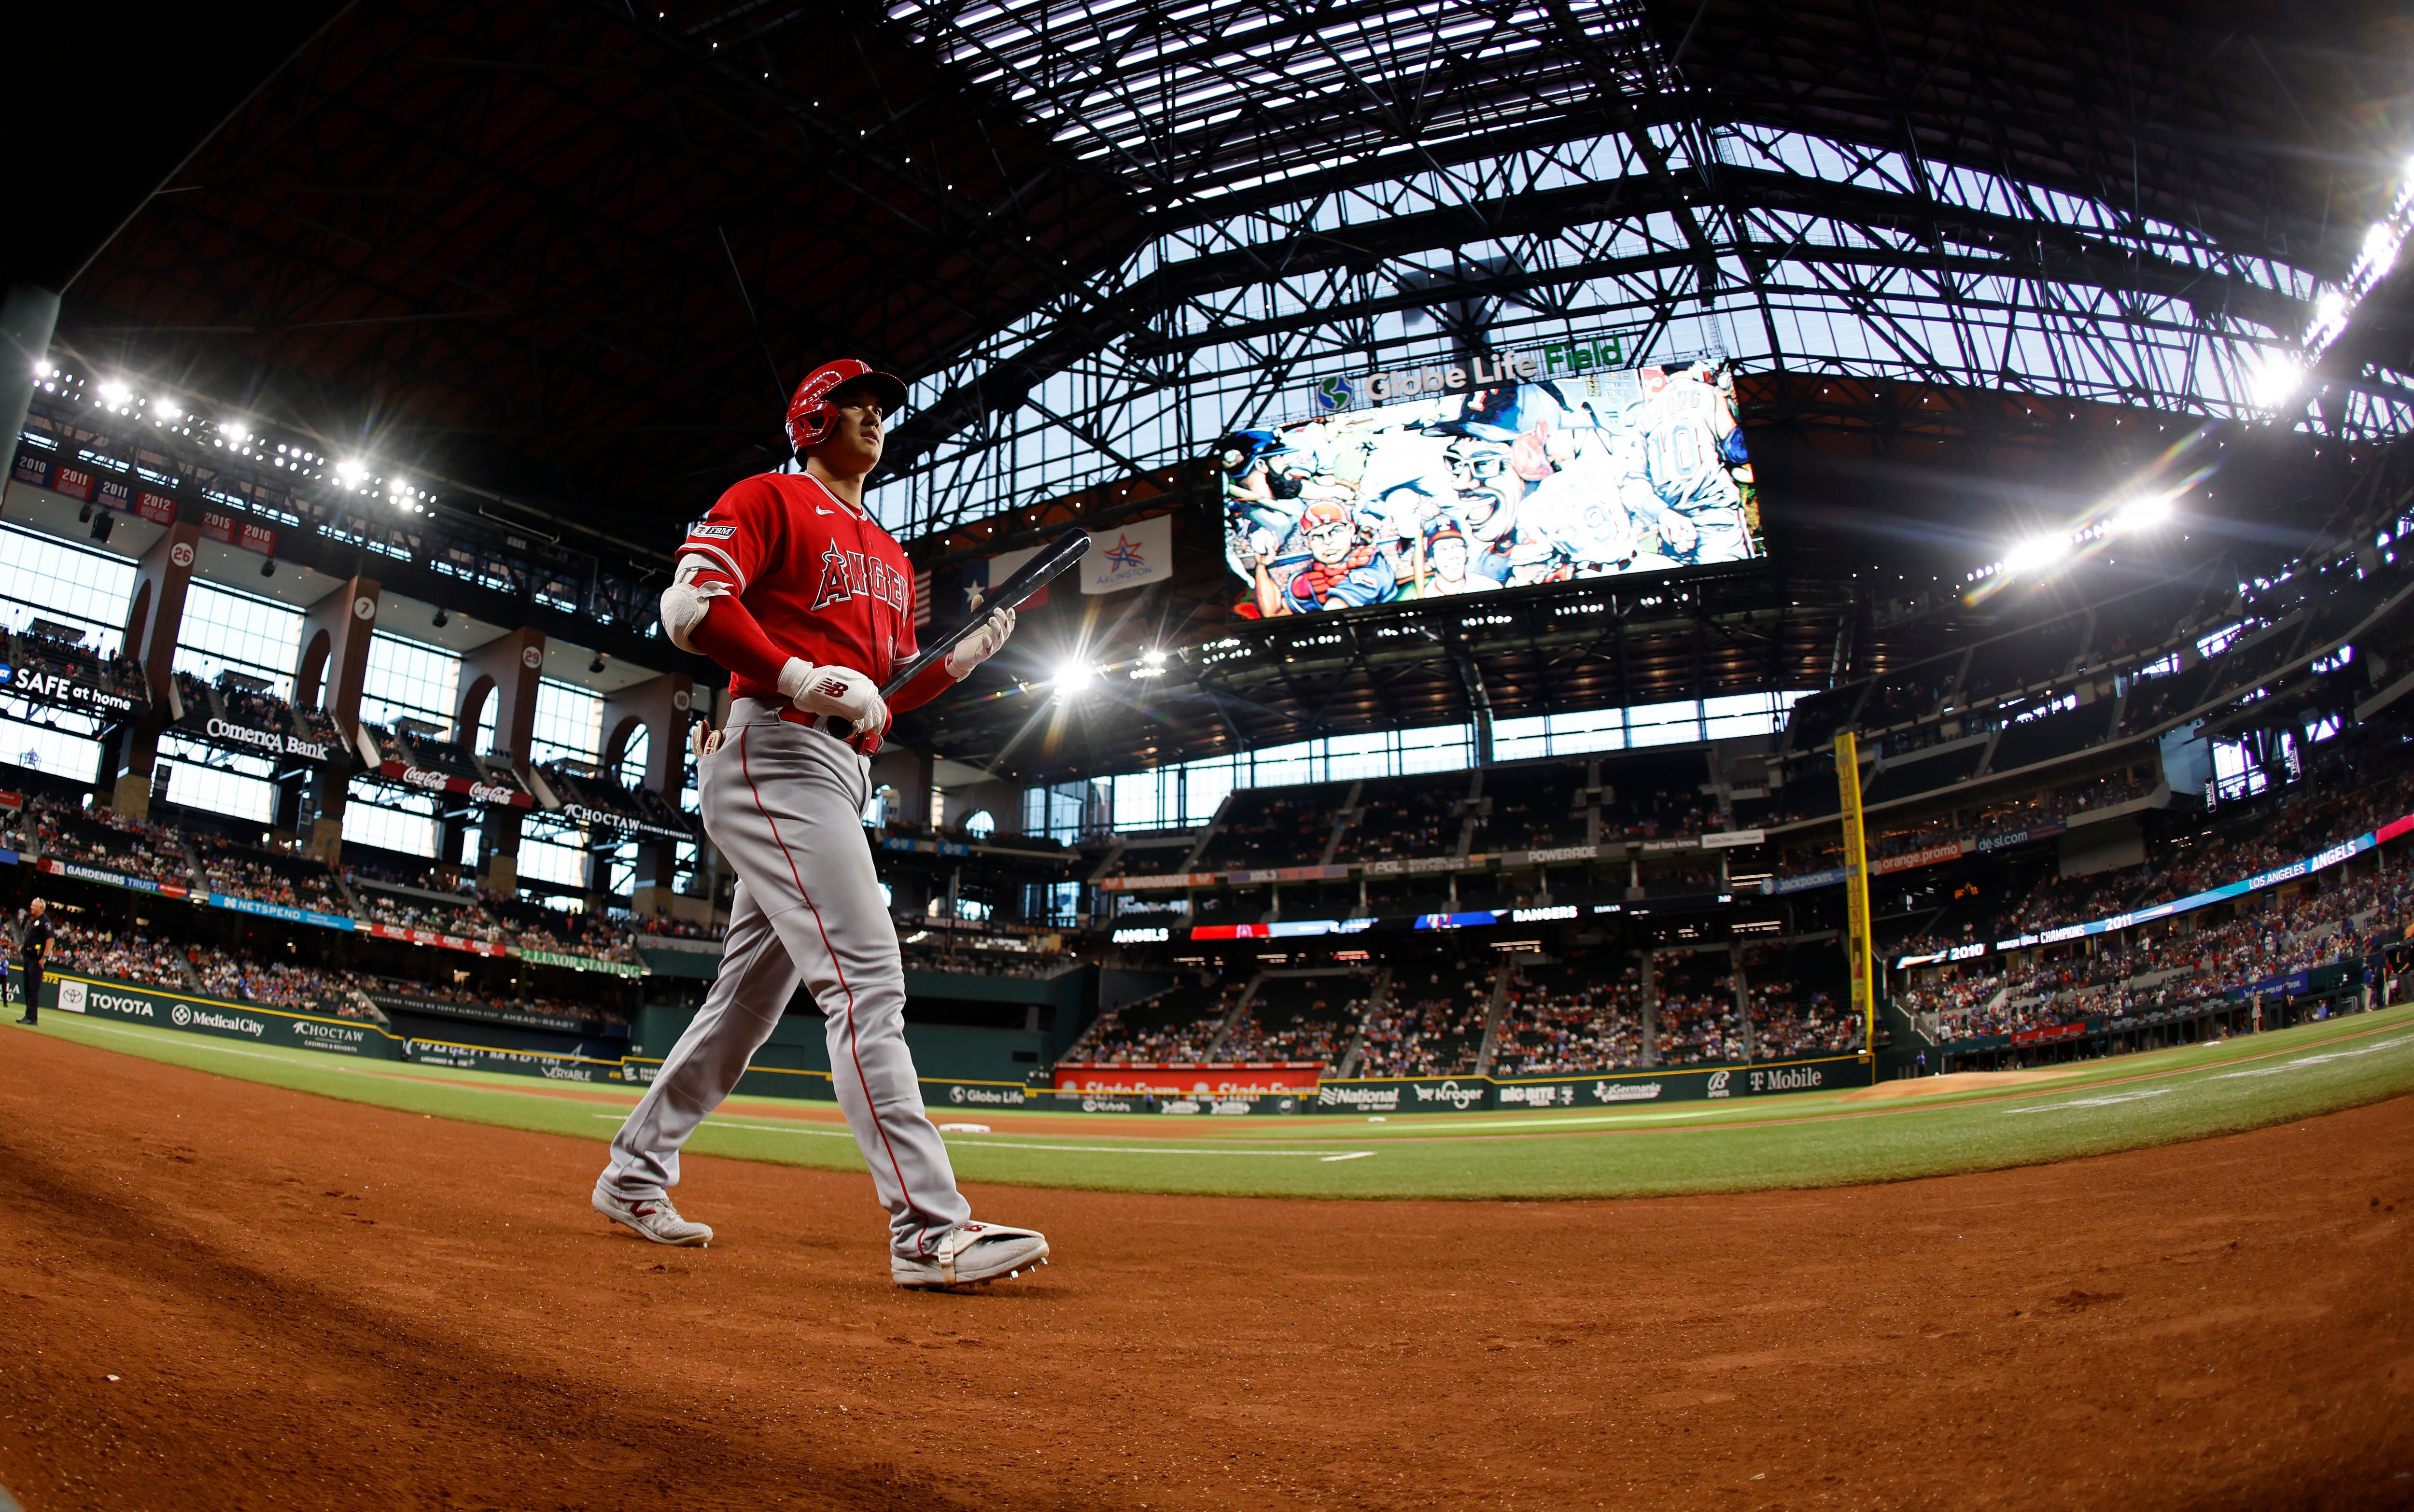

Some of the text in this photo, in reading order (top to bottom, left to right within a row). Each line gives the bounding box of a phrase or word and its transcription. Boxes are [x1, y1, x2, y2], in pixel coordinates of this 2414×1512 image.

[1365, 334, 1624, 401] Globe Life Field
[20, 456, 46, 473] 2010
[62, 469, 88, 485] 2011
[103, 482, 127, 498] 2011
[144, 494, 170, 511] 2012
[204, 512, 230, 529] 2015
[244, 525, 271, 541] 2016
[173, 547, 192, 562] 26
[1096, 566, 1152, 584] ARLINGTON
[361, 602, 370, 614] 7
[525, 649, 540, 664] 29
[15, 668, 70, 700] SAFE
[72, 687, 90, 700] at
[92, 689, 131, 711] home
[677, 695, 687, 707] 10
[286, 736, 329, 761] Bank
[2204, 782, 2214, 806] TRULY
[571, 803, 640, 831] CHOCTAW
[669, 830, 694, 841] RESORTS
[1528, 846, 1598, 863] POWERADE
[1883, 844, 1958, 869] orange.promo
[2248, 840, 2357, 890] LOS ANGELES ANGELS
[66, 864, 126, 885] GARDENERS
[127, 877, 158, 891] TRUST
[238, 900, 302, 920] NETSPEND
[1512, 905, 1578, 923] RANGERS
[2105, 913, 2133, 932] 2011
[1112, 927, 1169, 943] ANGELS
[1996, 924, 2086, 950] AMERICAN LEAGUE CHAMPIONS
[1950, 943, 1986, 960] 2010
[532, 951, 641, 978] LUXOR STAFFING
[90, 992, 154, 1017] TOYOTA
[193, 1010, 265, 1037] Medical City
[300, 1022, 364, 1042] CHOCTAW
[541, 1065, 591, 1082] VERYABLE
[1750, 1066, 1823, 1091] T Mobile
[967, 1089, 1025, 1105] Globe Life
[1336, 1087, 1400, 1104] National
[1434, 1080, 1484, 1109] Kroger
[1525, 1086, 1557, 1102] BITE
[1707, 1089, 1731, 1098] SPORTS
